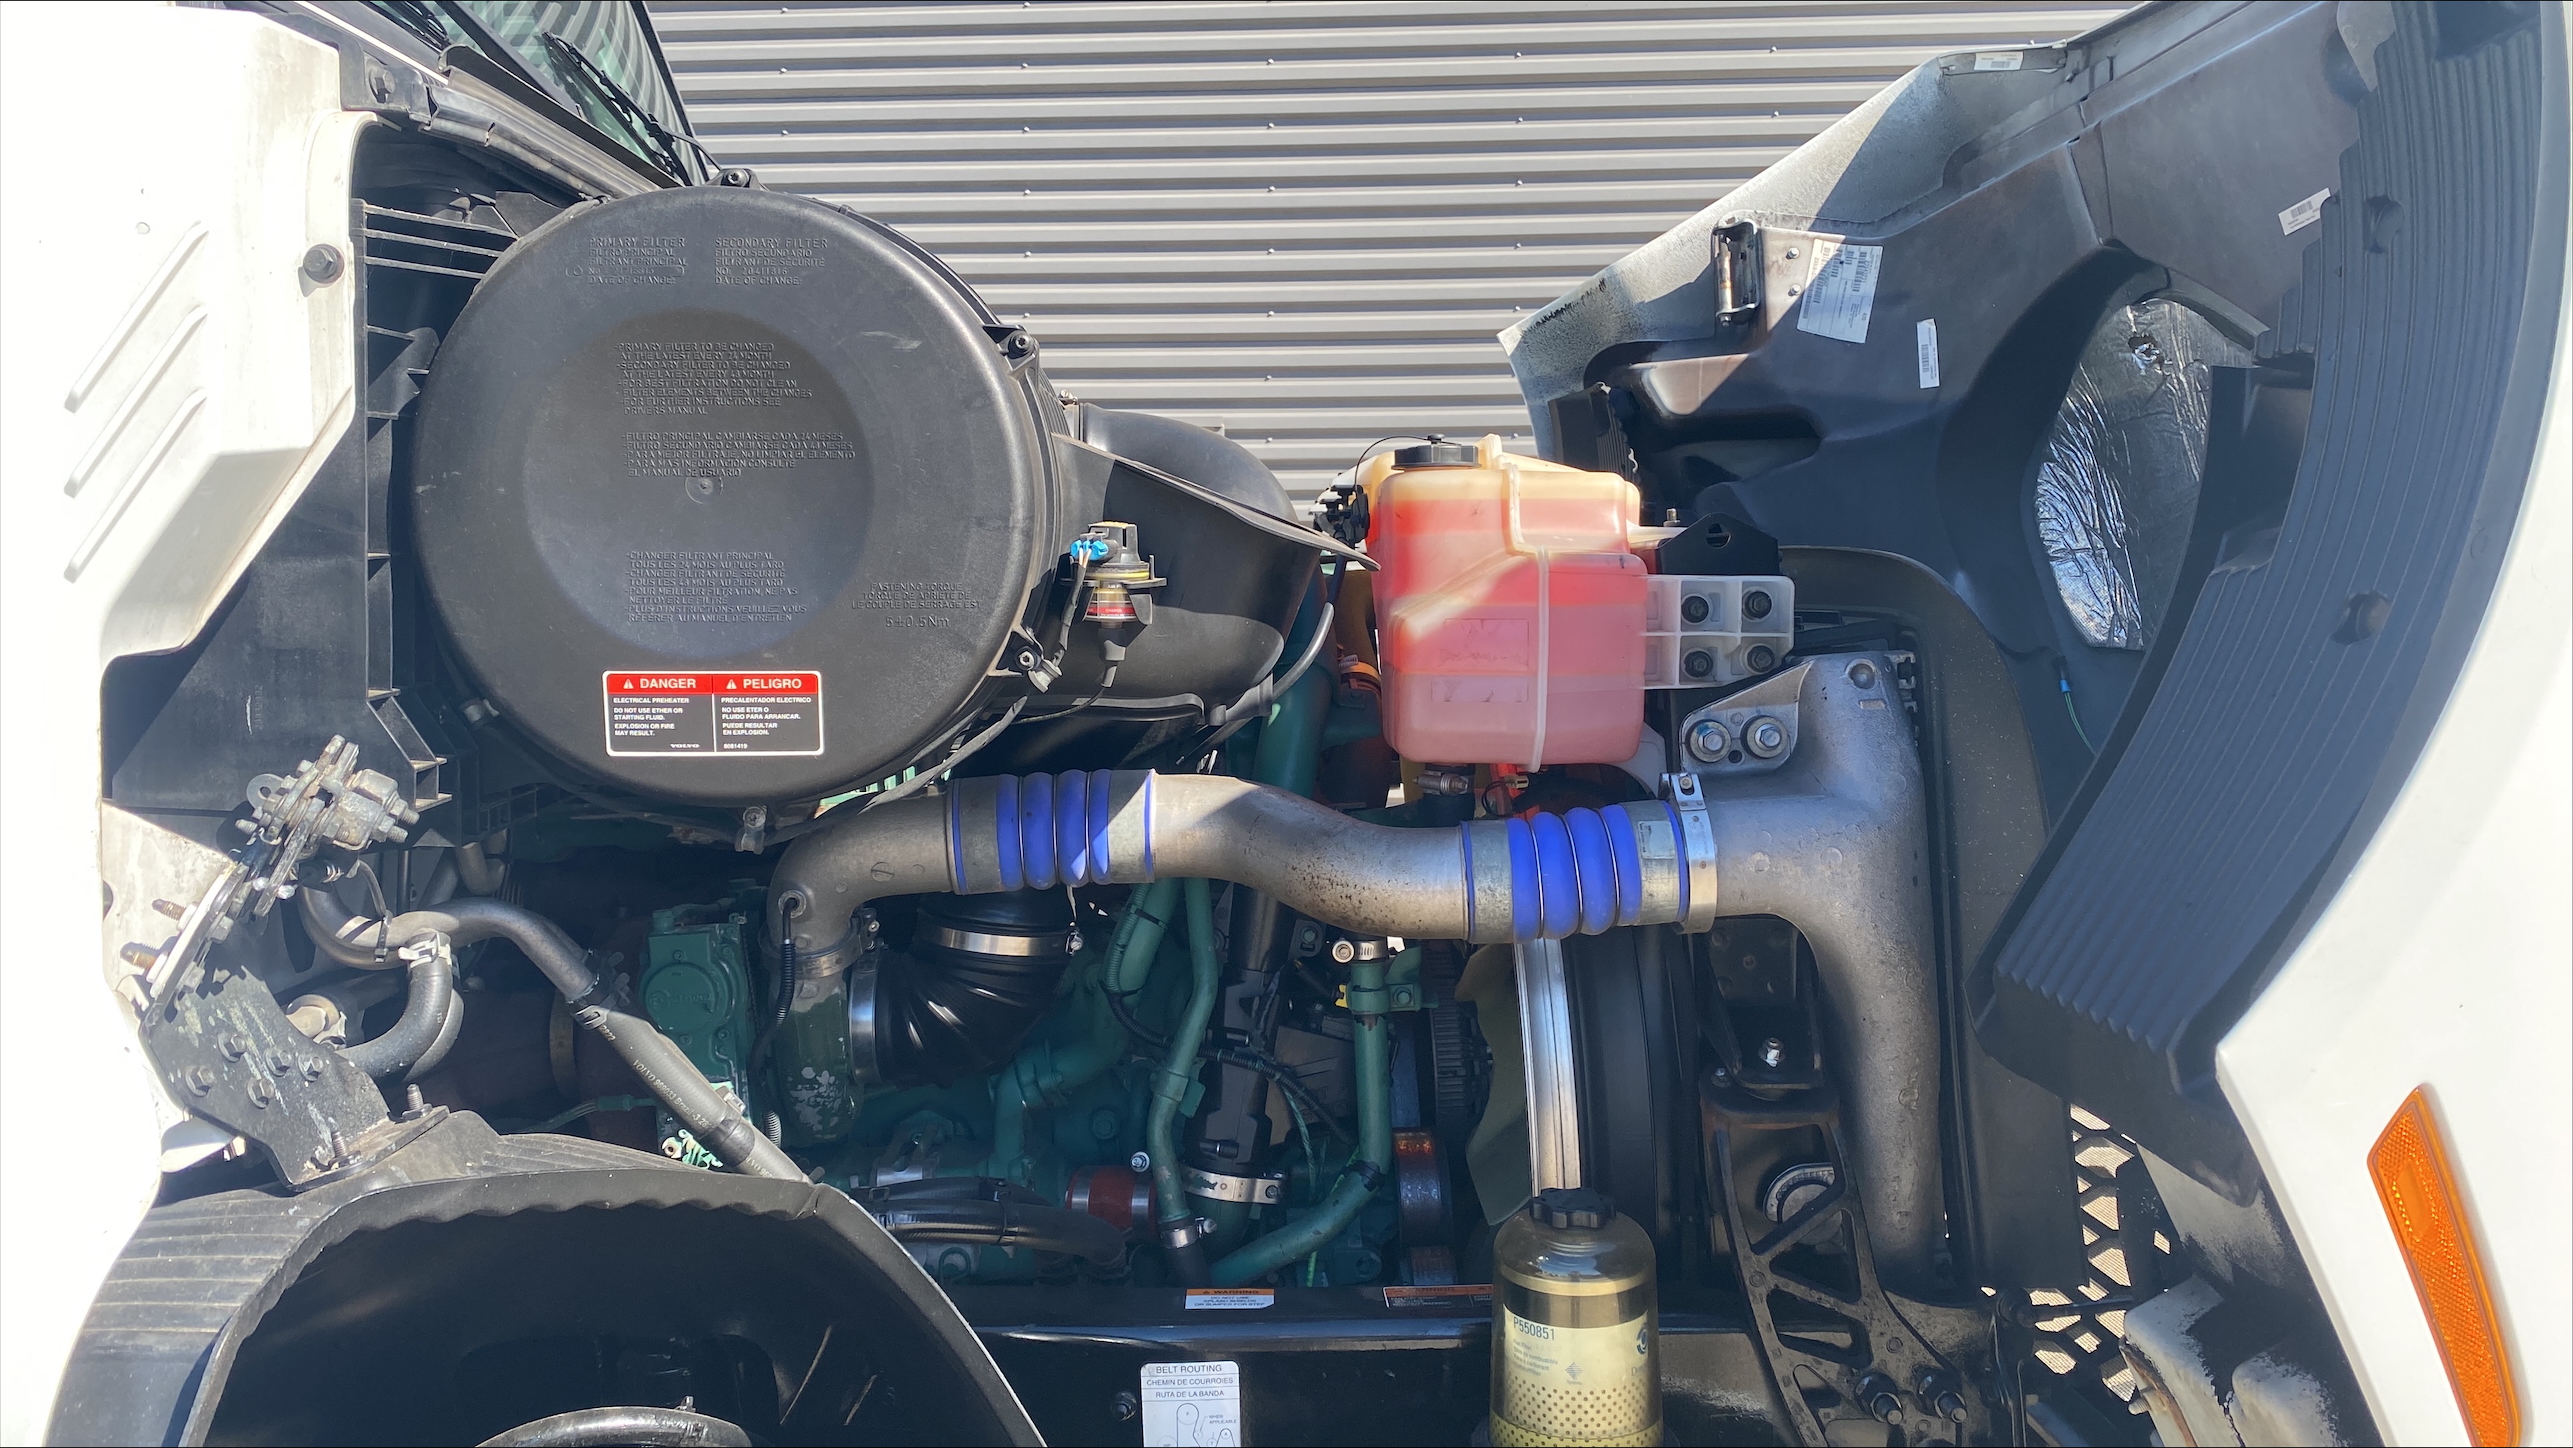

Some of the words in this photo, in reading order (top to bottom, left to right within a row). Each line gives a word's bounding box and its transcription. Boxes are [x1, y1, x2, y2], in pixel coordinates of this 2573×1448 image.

[589, 237, 638, 247] PRIMARY
[643, 237, 686, 247] FILTER
[715, 237, 780, 248] SECONDARY
[786, 237, 828, 248] FILTER
[715, 248, 749, 257] FILTRO
[751, 248, 813, 257] SECUNDARIO
[715, 276, 742, 285] DATE
[744, 276, 757, 285] OF
[665, 342, 698, 351] FILTER
[700, 342, 713, 351] TO
[715, 342, 728, 351] BE
[729, 342, 775, 351] CHANGED
[621, 352, 632, 360] AT
[634, 352, 654, 360] THE
[655, 352, 691, 360] LATEST
[693, 352, 724, 360] EVERY
[682, 361, 715, 369] FILTER
[717, 361, 730, 369] TO
[731, 361, 744, 369] BE
[746, 361, 791, 369] CHANGED
[636, 370, 655, 378] THE
[657, 370, 693, 378] LATEST
[696, 370, 727, 378] EVERY
[645, 379, 669, 387] BEST
[766, 379, 798, 387] CLEAN
[657, 388, 704, 397] ELEMENTS
[706, 388, 750, 397] BETWEEN
[752, 388, 769, 397] THE
[647, 397, 690, 406] FURTHER
[692, 397, 761, 406] INSTRUCTIONS
[762, 397, 782, 406] SEE
[624, 406, 666, 415] DRIVERS
[667, 406, 708, 415] MANUAL
[812, 432, 843, 440] MESES
[822, 441, 853, 450] MESES
[741, 450, 754, 459] NO
[678, 551, 724, 560] FILTRANT
[726, 551, 774, 560] PRINCIPAL
[630, 561, 656, 569] TOUS
[658, 561, 677, 569] LES
[692, 561, 716, 569] MOIS
[720, 561, 731, 569] AU
[733, 561, 757, 569] PLUS
[679, 569, 724, 578] FILTRANT
[630, 579, 655, 587] TOUS
[658, 579, 676, 587] LES
[658, 587, 704, 595] MEILLEUR
[765, 587, 777, 595] NE
[629, 596, 679, 604] NETTOYER
[640, 678, 696, 689] DANGER
[743, 678, 802, 689] PELIGRO
[633, 1060, 655, 1081] VOLVO
[674, 1097, 694, 1116] Brazil
[1514, 1316, 1555, 1341] P550851
[1156, 1365, 1178, 1374] BELT
[1180, 1364, 1222, 1373] ROUTING
[1189, 1377, 1234, 1385] COURROIES
